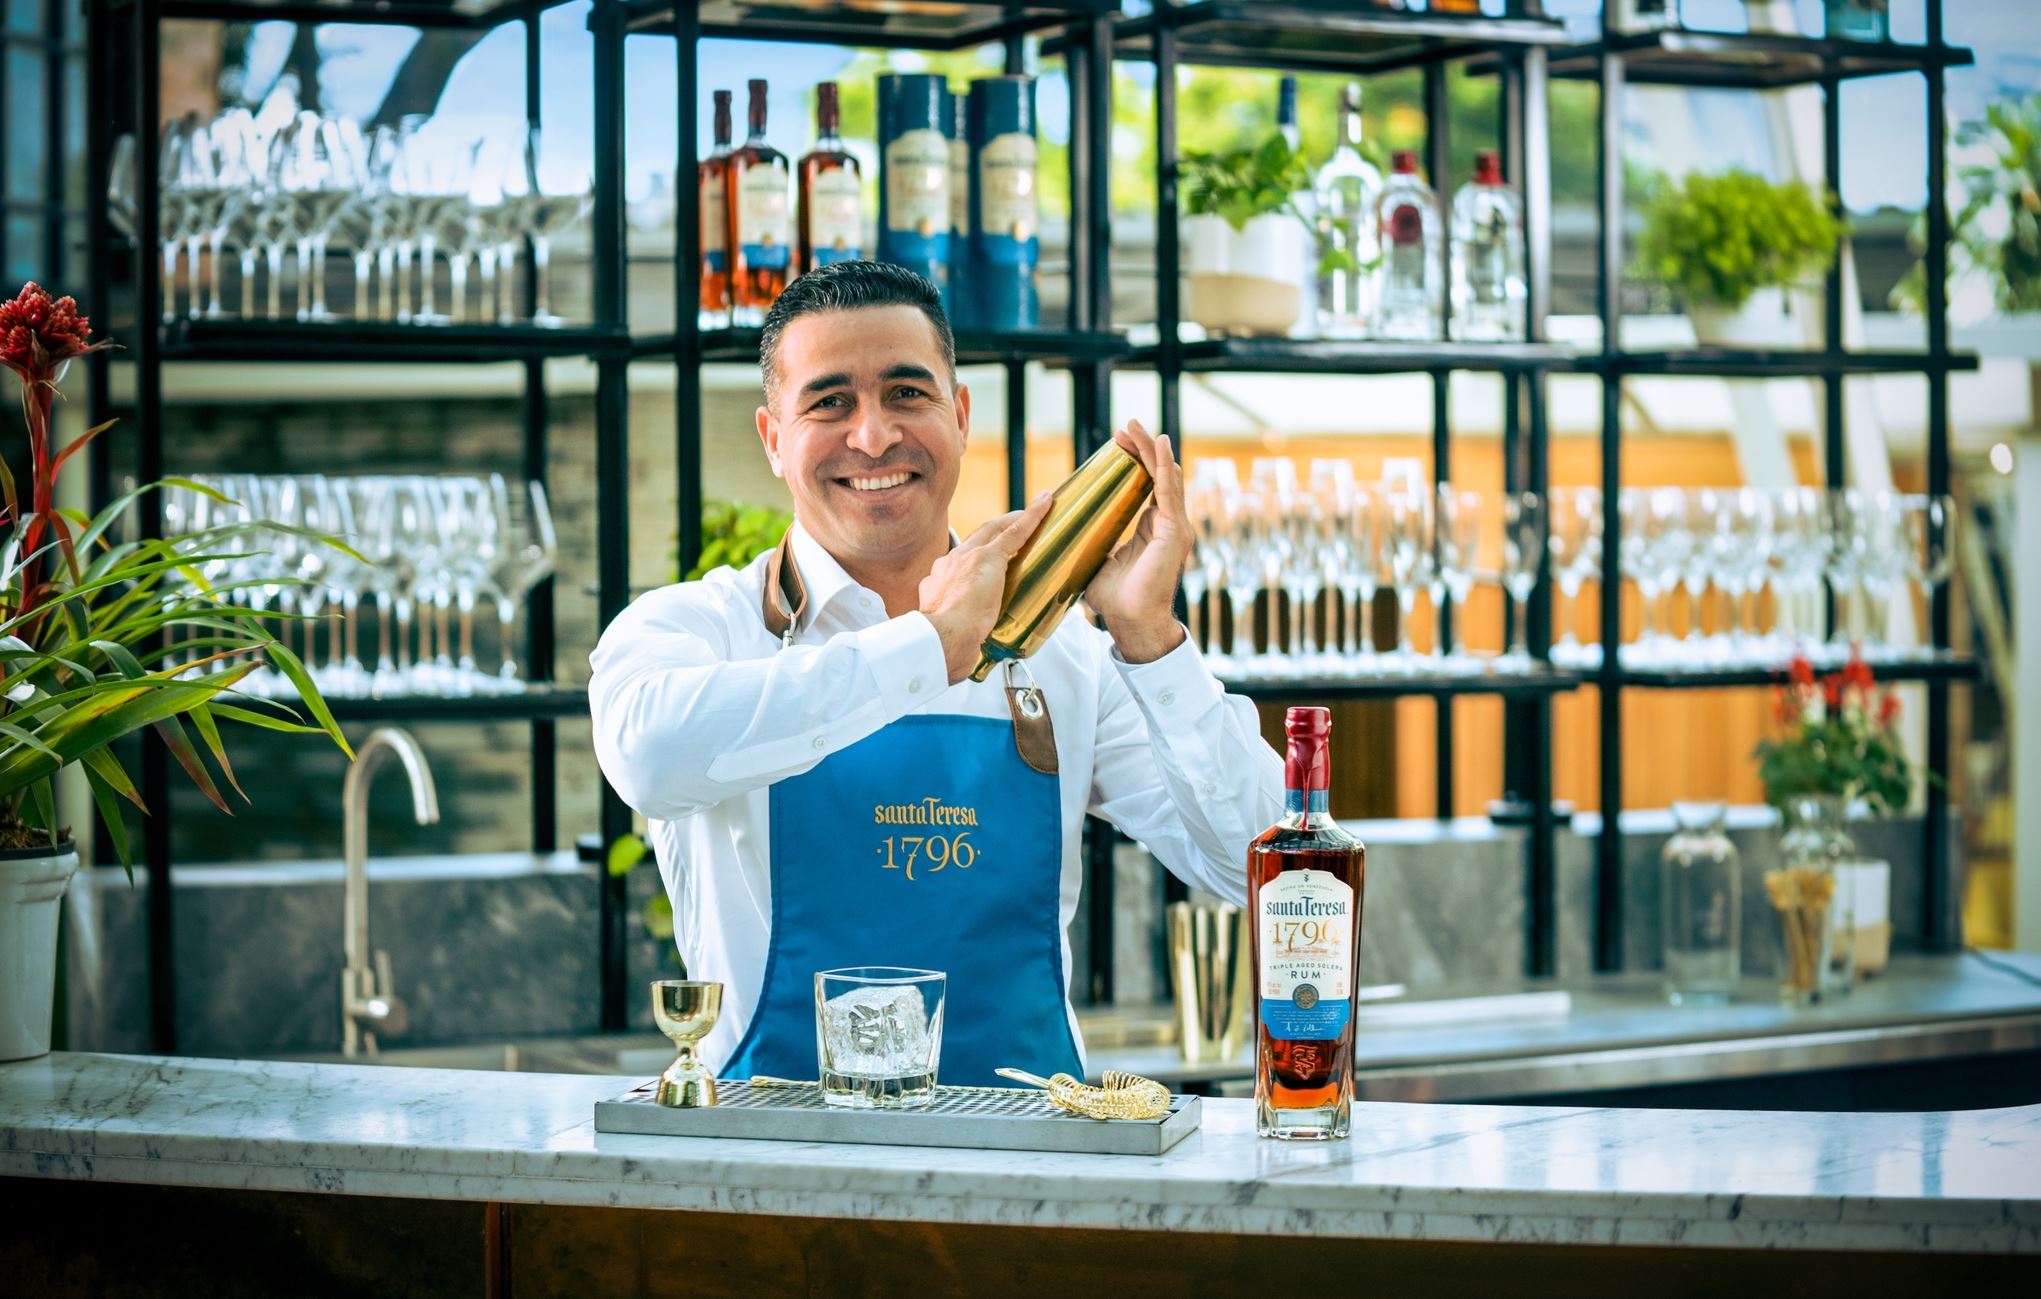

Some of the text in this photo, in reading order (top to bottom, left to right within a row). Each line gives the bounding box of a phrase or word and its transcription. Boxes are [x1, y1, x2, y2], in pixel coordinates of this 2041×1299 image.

[881, 832, 975, 881] 1796
[1269, 963, 1293, 971] TRIPLE
[1317, 963, 1343, 971] SOLERA
[1290, 970, 1321, 979] RUM
